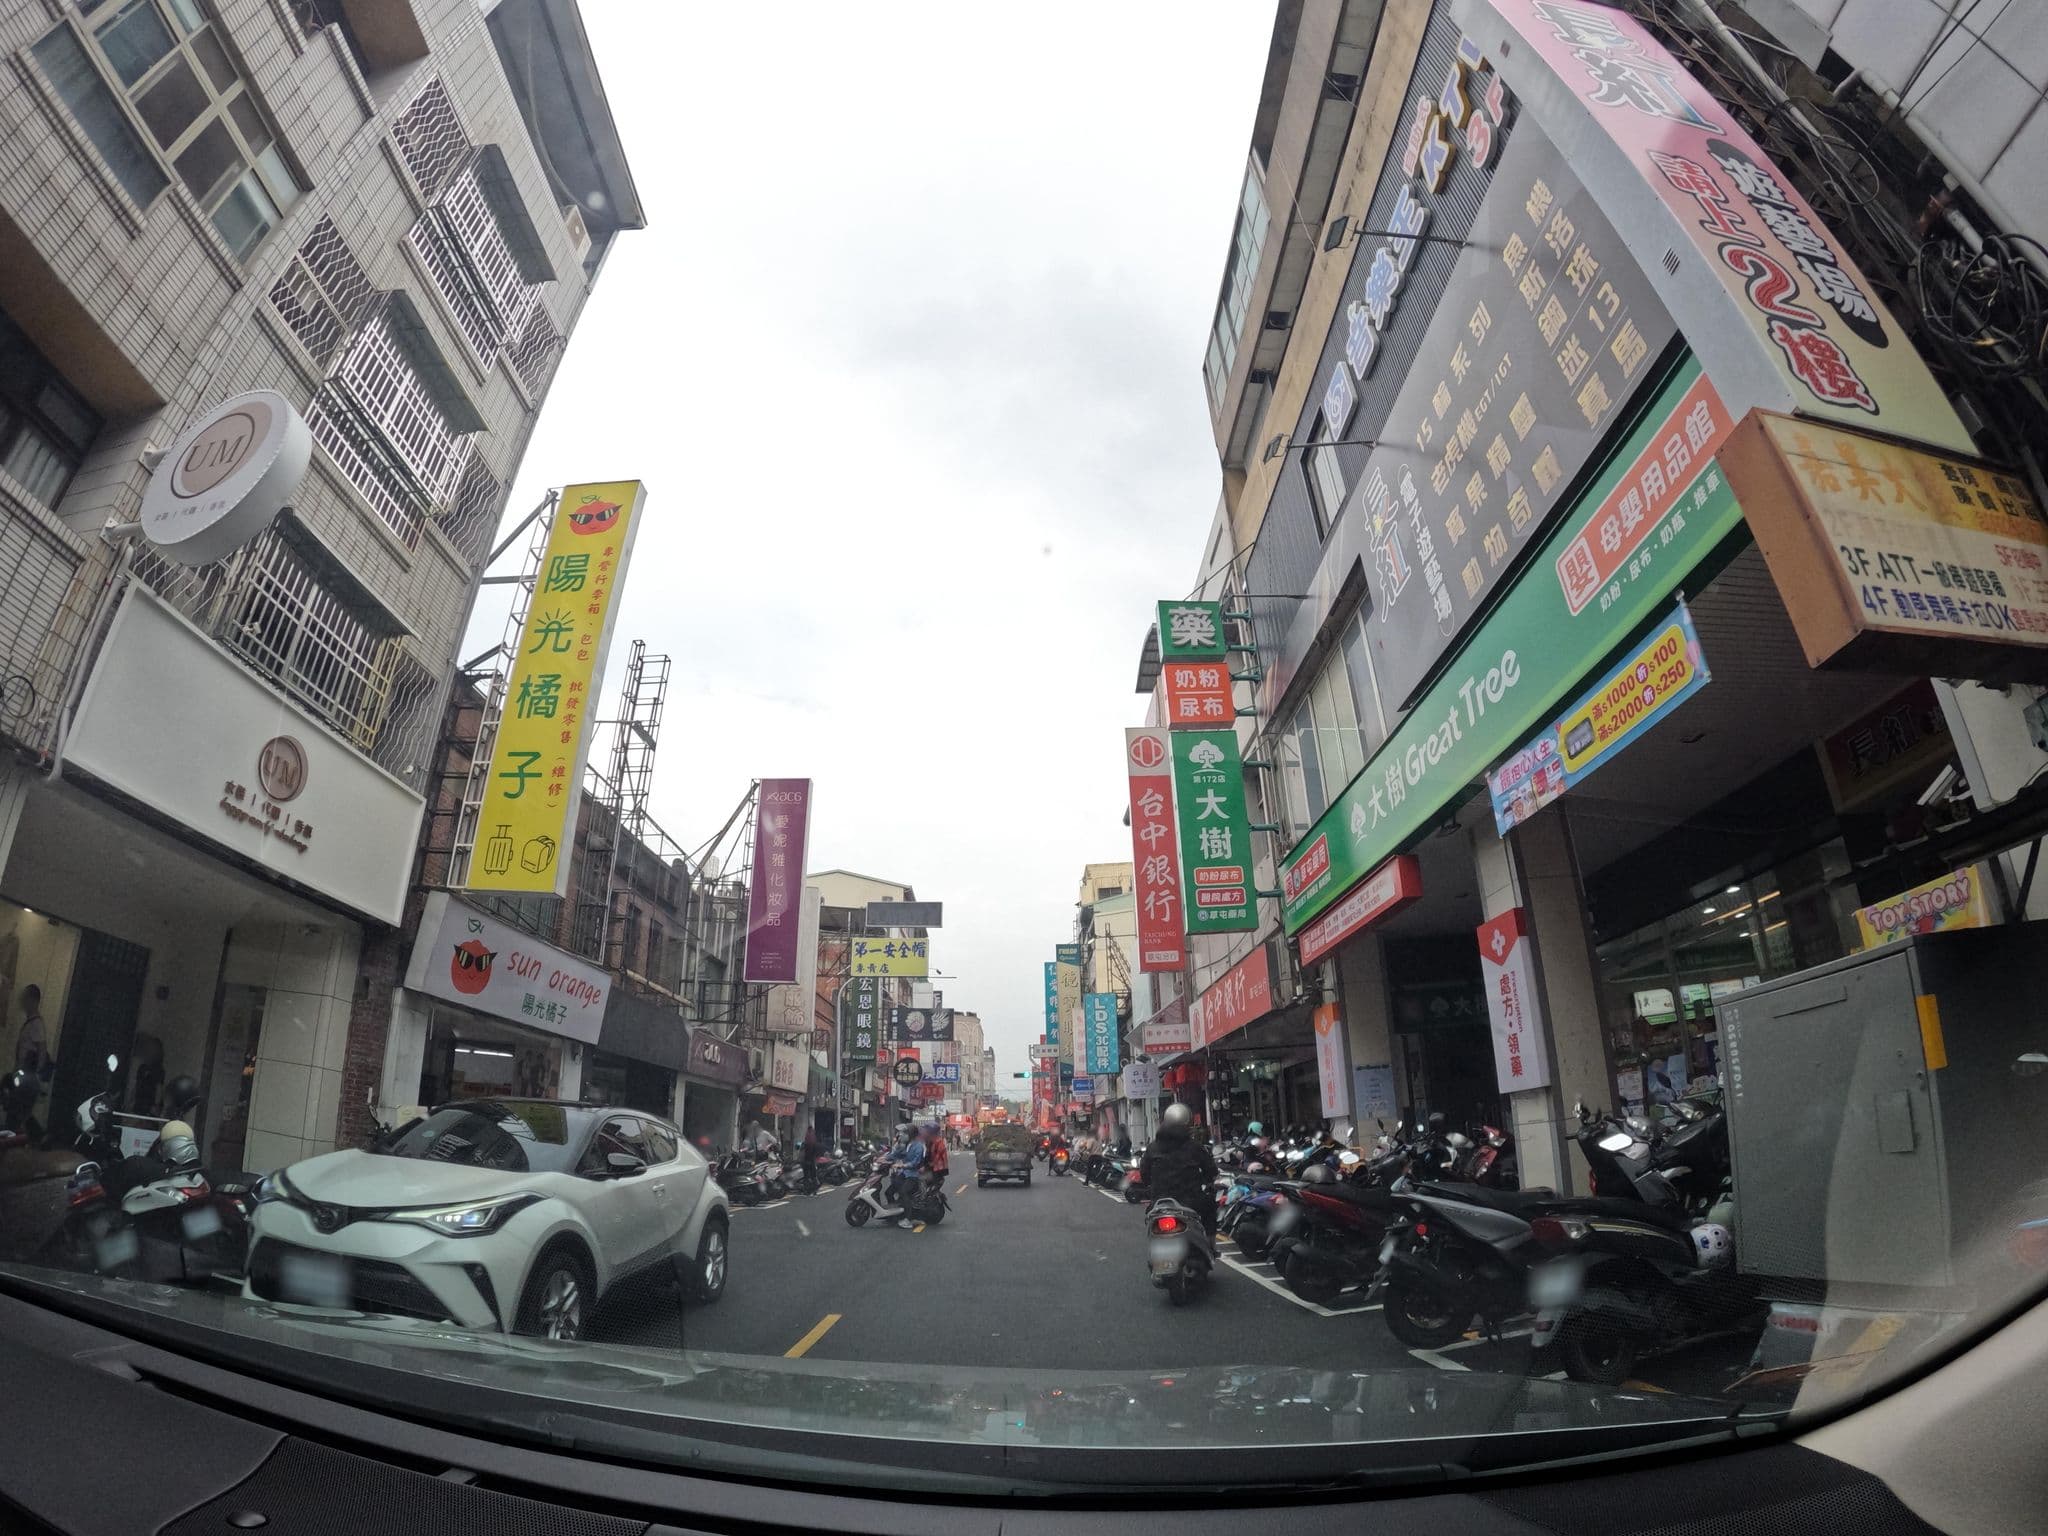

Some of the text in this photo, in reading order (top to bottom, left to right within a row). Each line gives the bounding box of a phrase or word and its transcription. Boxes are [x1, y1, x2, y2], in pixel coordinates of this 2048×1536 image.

[1403, 97, 1430, 175] 自助式
[1346, 184, 1429, 380] 音樂王
[1519, 208, 1574, 311] 斯洛
[1538, 242, 1599, 347] 鋼珠
[1646, 149, 1880, 415] 請上2樓
[1557, 281, 1620, 386] 迷13
[1577, 319, 1647, 430] 賽馬
[184, 432, 247, 473] UM
[1431, 352, 1512, 496] 老虎機 EGT/IGT
[1461, 444, 1562, 600] 動物奇觀
[1600, 399, 1717, 556] 母嬰用品館
[1400, 471, 1452, 622] 電子遊藝場
[1168, 606, 1217, 648] 藥
[499, 553, 590, 799] 陽光橘子
[560, 681, 583, 744] 批發零售
[1175, 669, 1220, 689] 奶粉
[1179, 697, 1223, 717] 尿布
[1369, 649, 1521, 829] 大樹 Great Tree
[1137, 787, 1176, 922] 台中銀行
[1195, 788, 1233, 860] 大樹
[766, 814, 790, 927] 愛妮雅化妝品
[1199, 871, 1240, 882] 奶粉尿布
[1869, 877, 1971, 934] TOY STORY
[507, 951, 601, 1009] sun orange
[854, 941, 927, 959] 第一安全帽
[521, 992, 568, 1025] 陽光橘子
[856, 977, 873, 1049] 宏恩眼鏡
[1206, 967, 1246, 1031] 台中銀行
